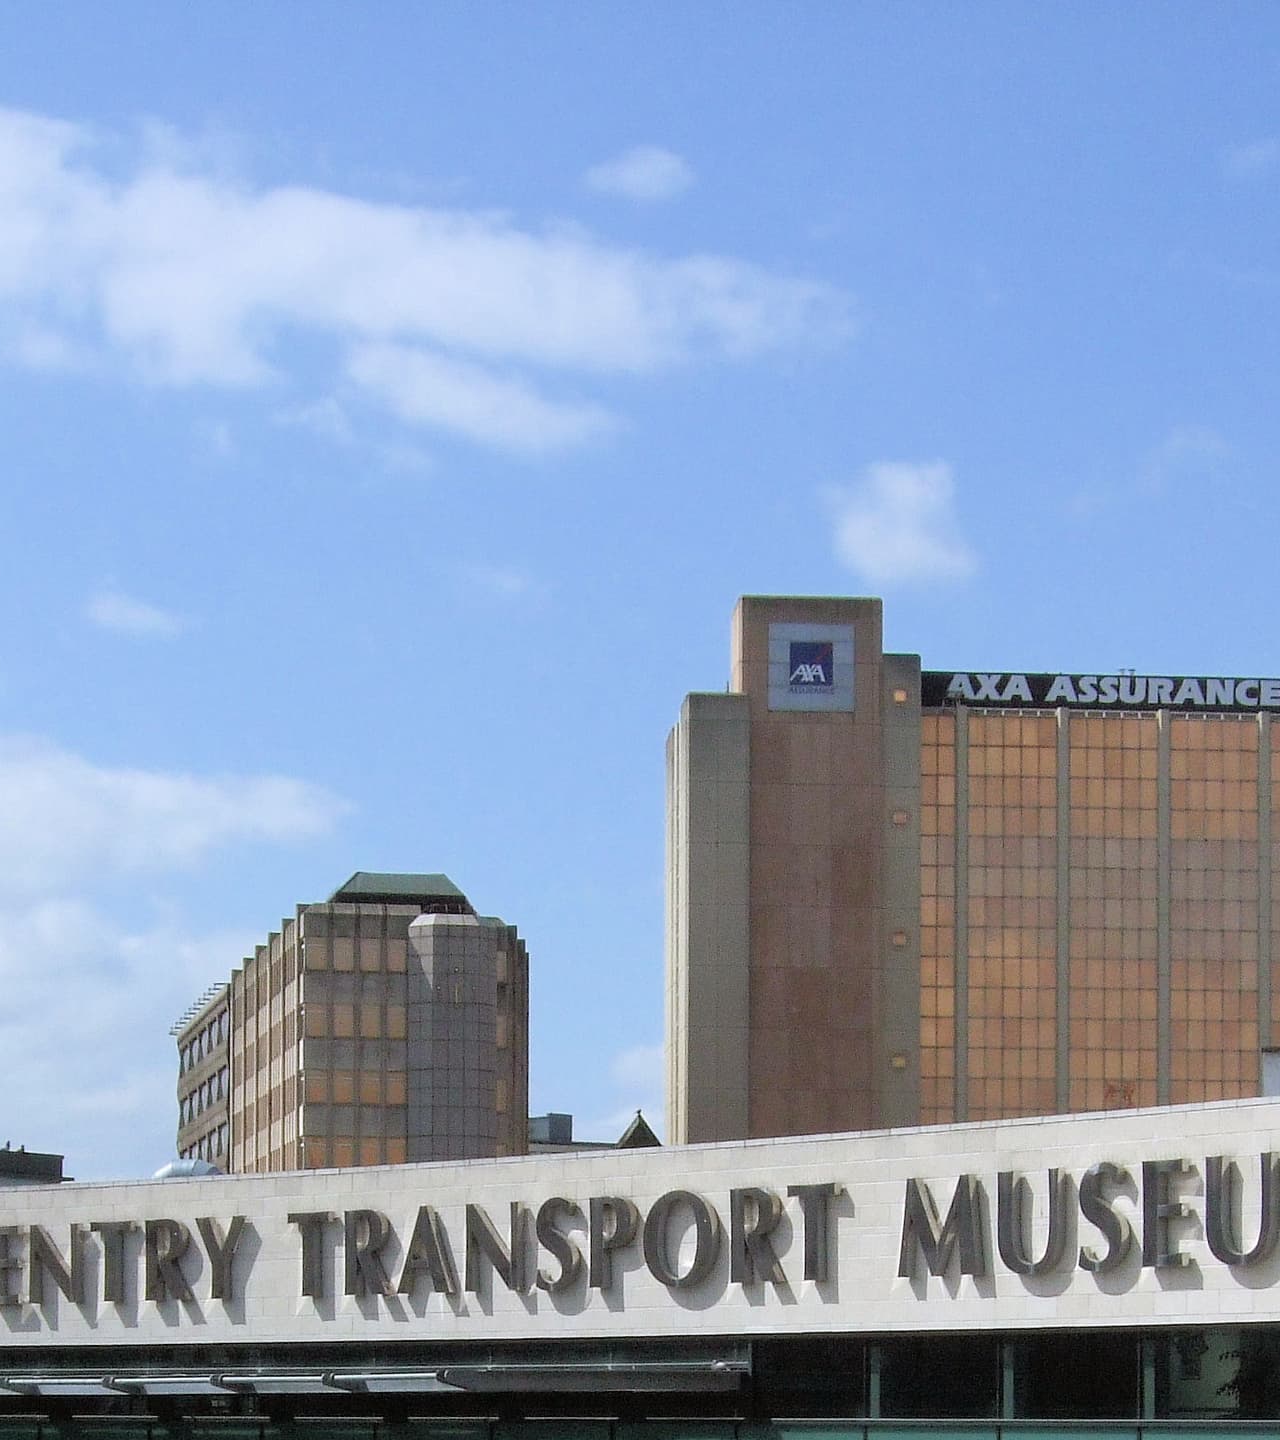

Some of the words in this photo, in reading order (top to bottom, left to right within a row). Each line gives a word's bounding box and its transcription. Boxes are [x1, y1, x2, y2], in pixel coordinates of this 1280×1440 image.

[790, 664, 825, 682] AXA
[947, 673, 1034, 701] AXA
[287, 1182, 844, 1297] TRANSPORT
